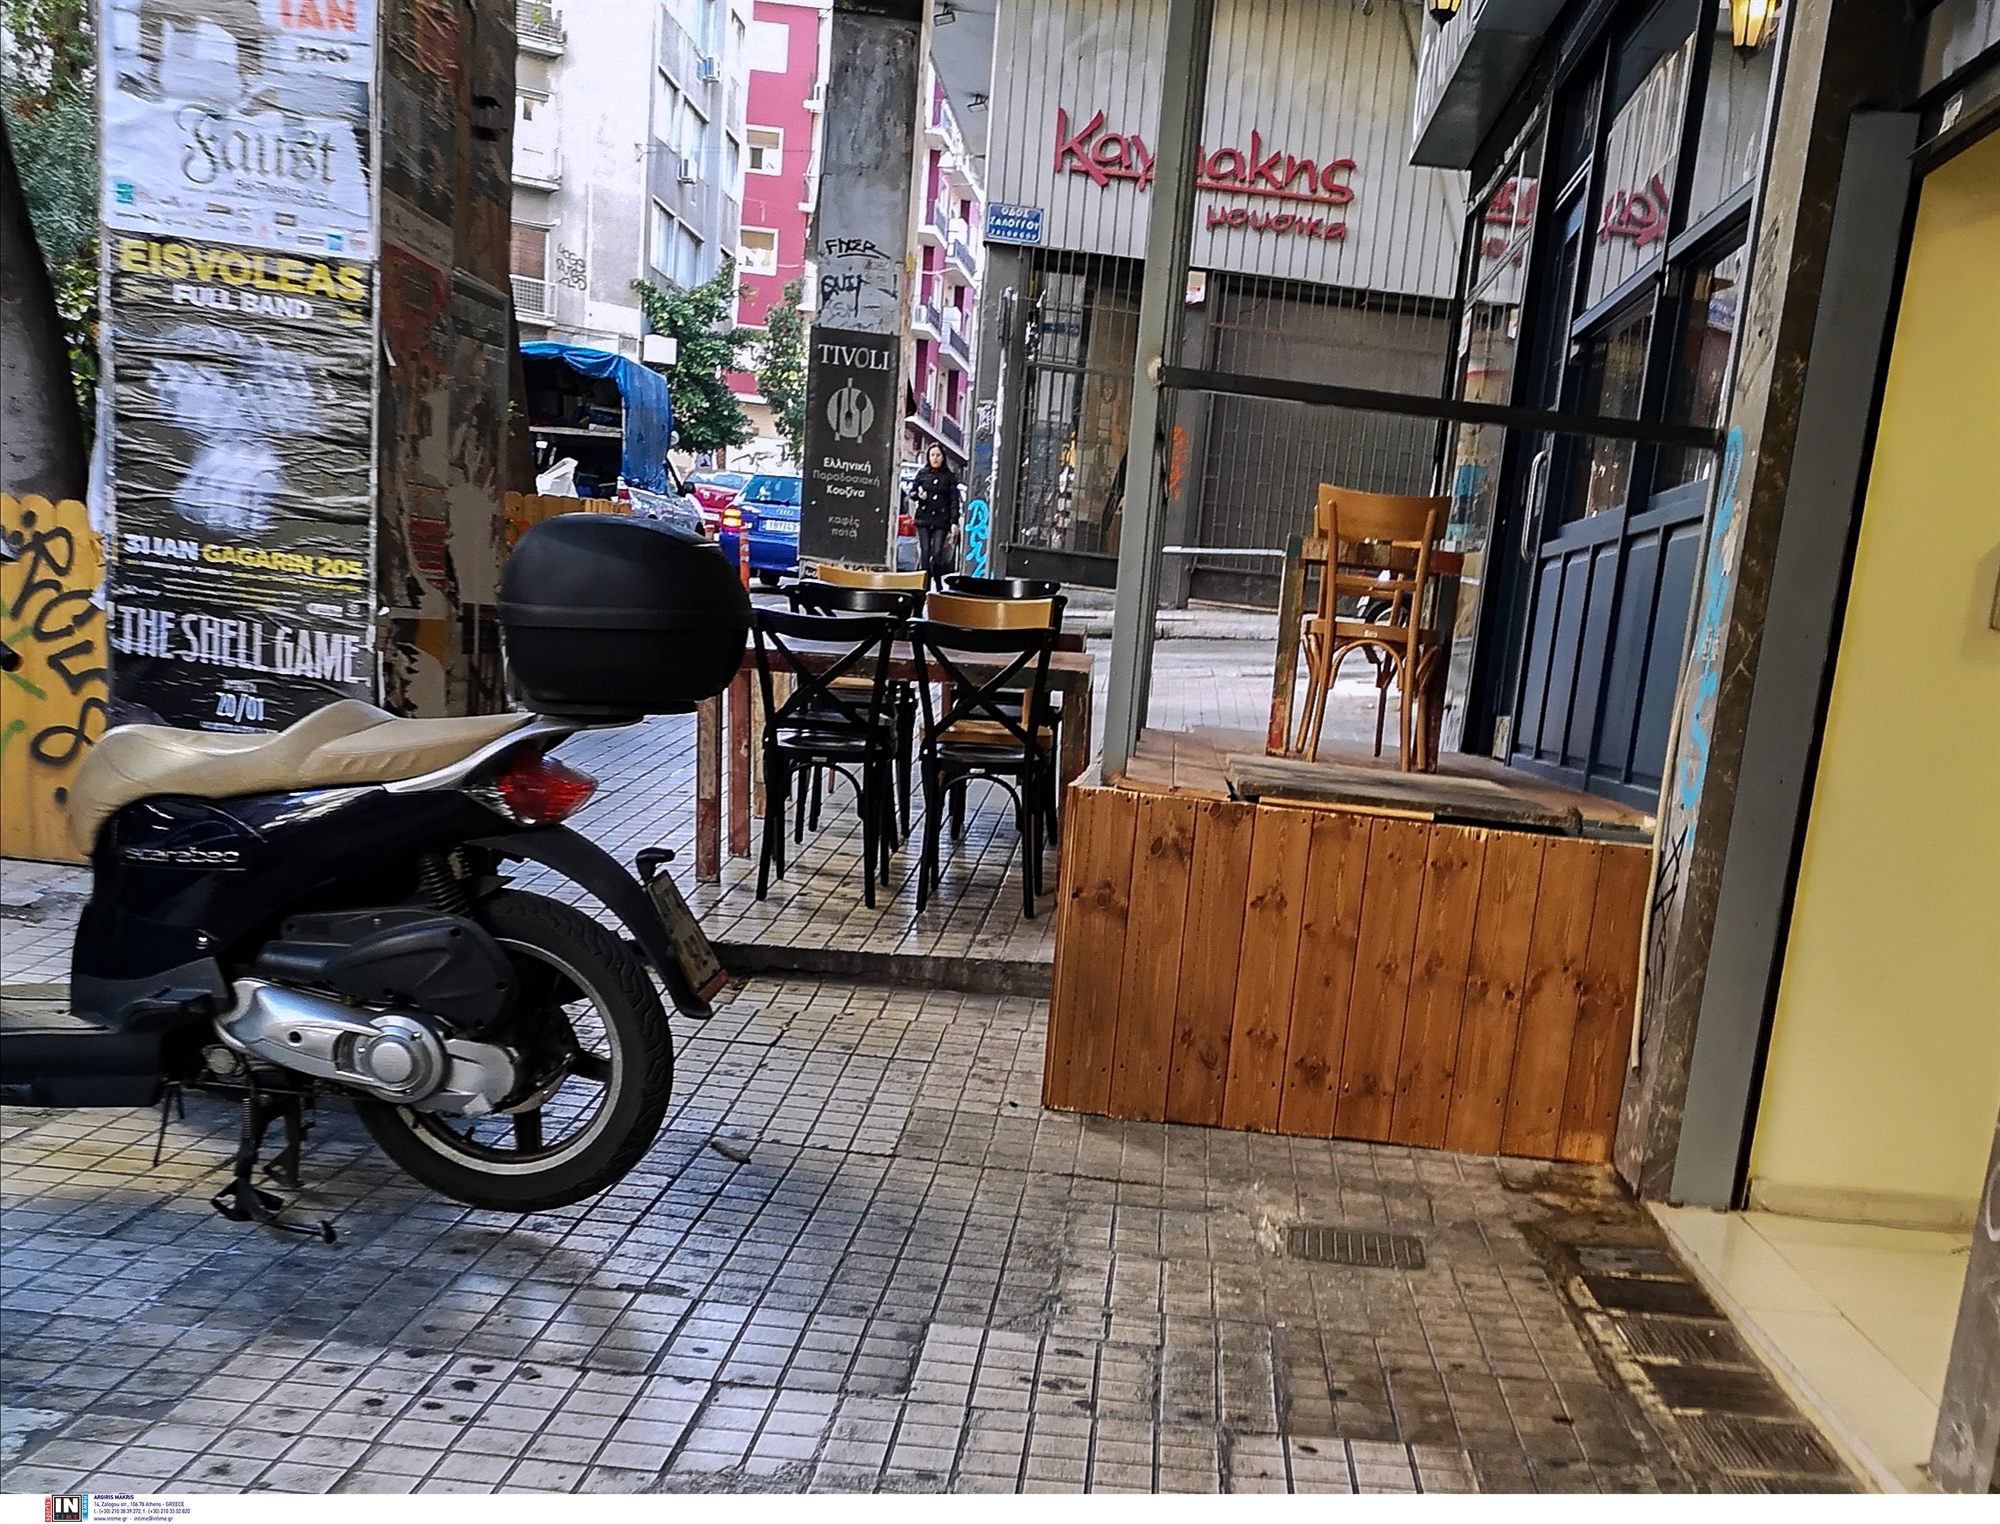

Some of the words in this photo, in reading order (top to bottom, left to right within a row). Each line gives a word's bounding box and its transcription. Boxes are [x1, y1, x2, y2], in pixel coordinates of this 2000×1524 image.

[1053, 107, 1356, 203] Καγακης
[119, 239, 364, 301] EISVOLEAS
[239, 294, 313, 319] BAND
[818, 343, 890, 371] TIVOLI
[823, 456, 872, 475] Ελληνική
[316, 556, 364, 579] 205
[117, 604, 176, 660] THE
[180, 612, 263, 670] SHELL
[274, 624, 367, 684] GAME
